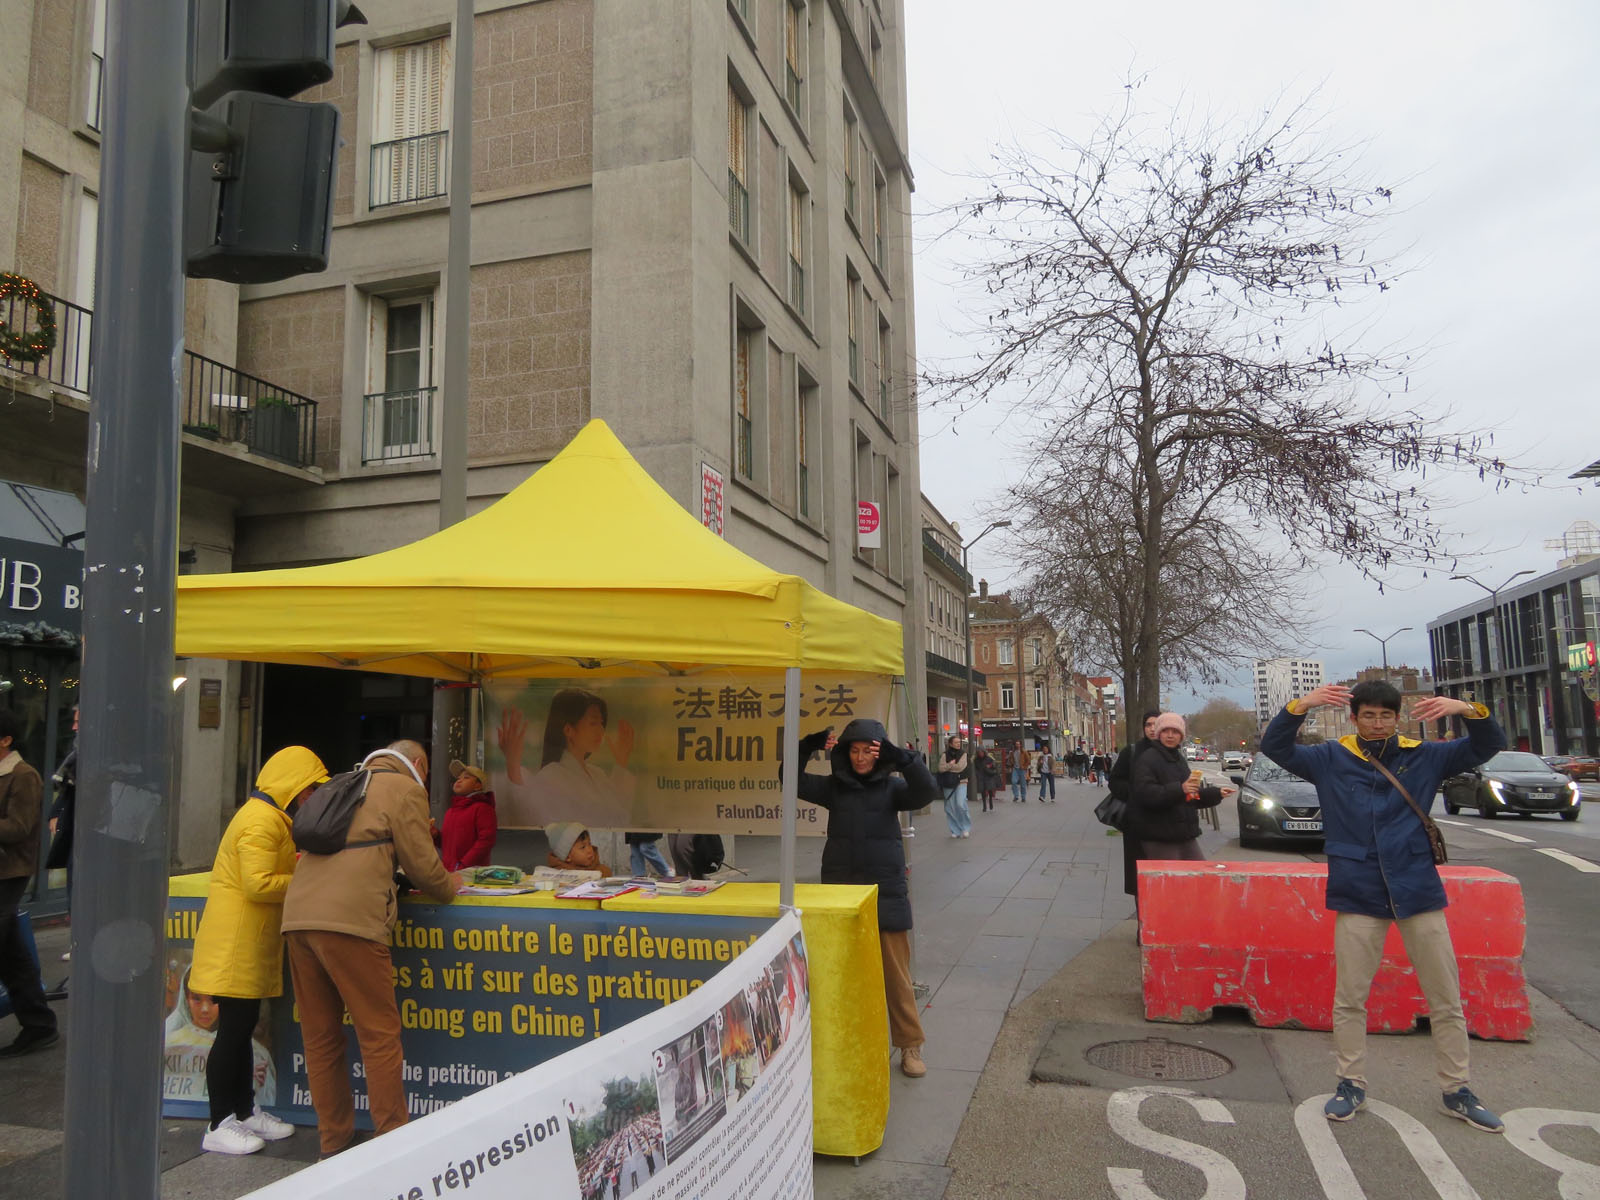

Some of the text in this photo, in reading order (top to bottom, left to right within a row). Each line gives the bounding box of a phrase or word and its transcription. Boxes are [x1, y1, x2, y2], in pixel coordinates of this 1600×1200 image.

[677, 726, 765, 762] Falun
[656, 776, 681, 791] Une
[684, 776, 736, 793] pratique
[739, 777, 755, 790] du
[453, 924, 540, 954] contre
[549, 923, 574, 956] le
[420, 958, 435, 990] à
[442, 961, 475, 991] vif
[482, 969, 525, 994] sur
[532, 965, 580, 997] des
[401, 998, 466, 1038] Gong
[472, 1010, 503, 1034] en
[511, 1003, 585, 1038] Chine
[402, 1059, 424, 1082] he
[428, 1063, 498, 1087] petition
[432, 1115, 561, 1197] répression
[676, 1156, 698, 1185] pouvoir
[698, 1133, 722, 1161] contrôler
[674, 1176, 698, 1200] massive
[699, 1183, 710, 1198] ont
